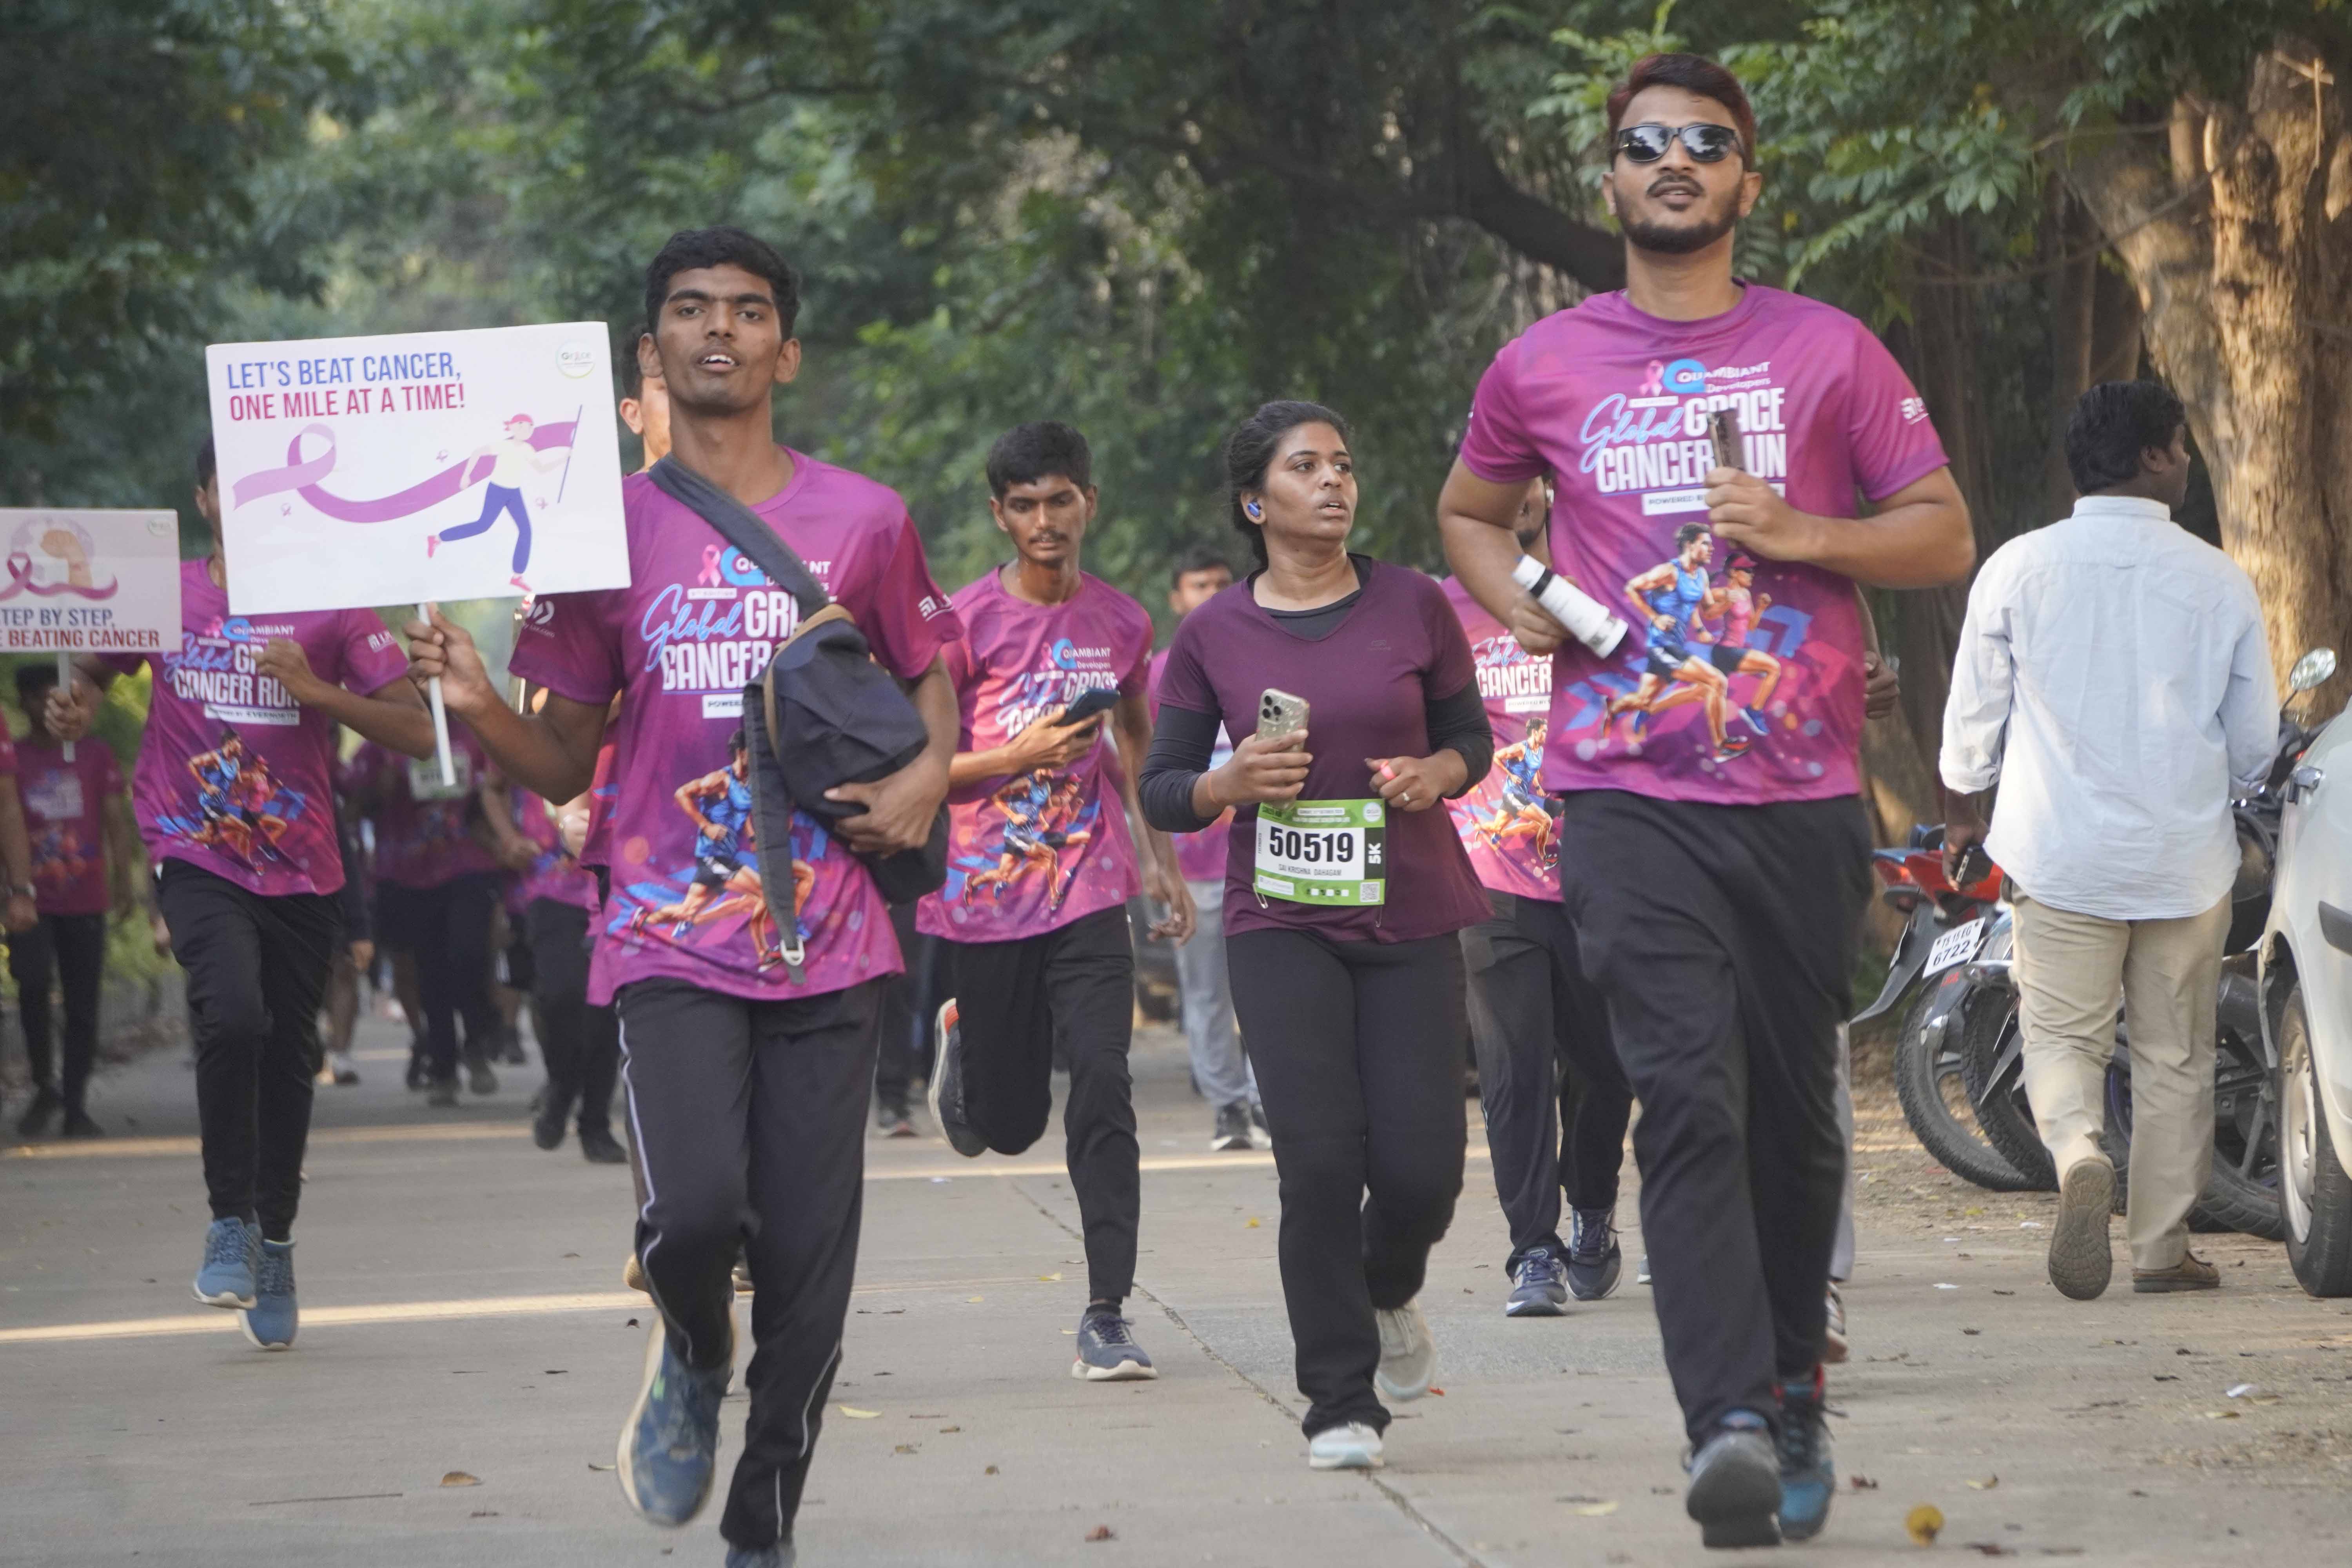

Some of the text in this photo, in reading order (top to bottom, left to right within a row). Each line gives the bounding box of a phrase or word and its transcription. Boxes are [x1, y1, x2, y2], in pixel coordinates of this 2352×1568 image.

[227, 352, 461, 389] LET'S BEAT CANCER,
[229, 383, 465, 421] ONE MILE AT A TIME!
[1580, 393, 1684, 473] Global
[1596, 439, 1716, 493] CANCER
[0, 608, 115, 628] TEP BY STEP,
[641, 583, 744, 673] Global
[8, 629, 84, 648] BEATING
[89, 629, 160, 648] CANCER
[175, 668, 253, 705] CANCER
[1475, 663, 1552, 697] CANCER
[1270, 826, 1354, 863] 50519
[1368, 842, 1382, 864] 5K
[1933, 940, 1970, 967] 6722
